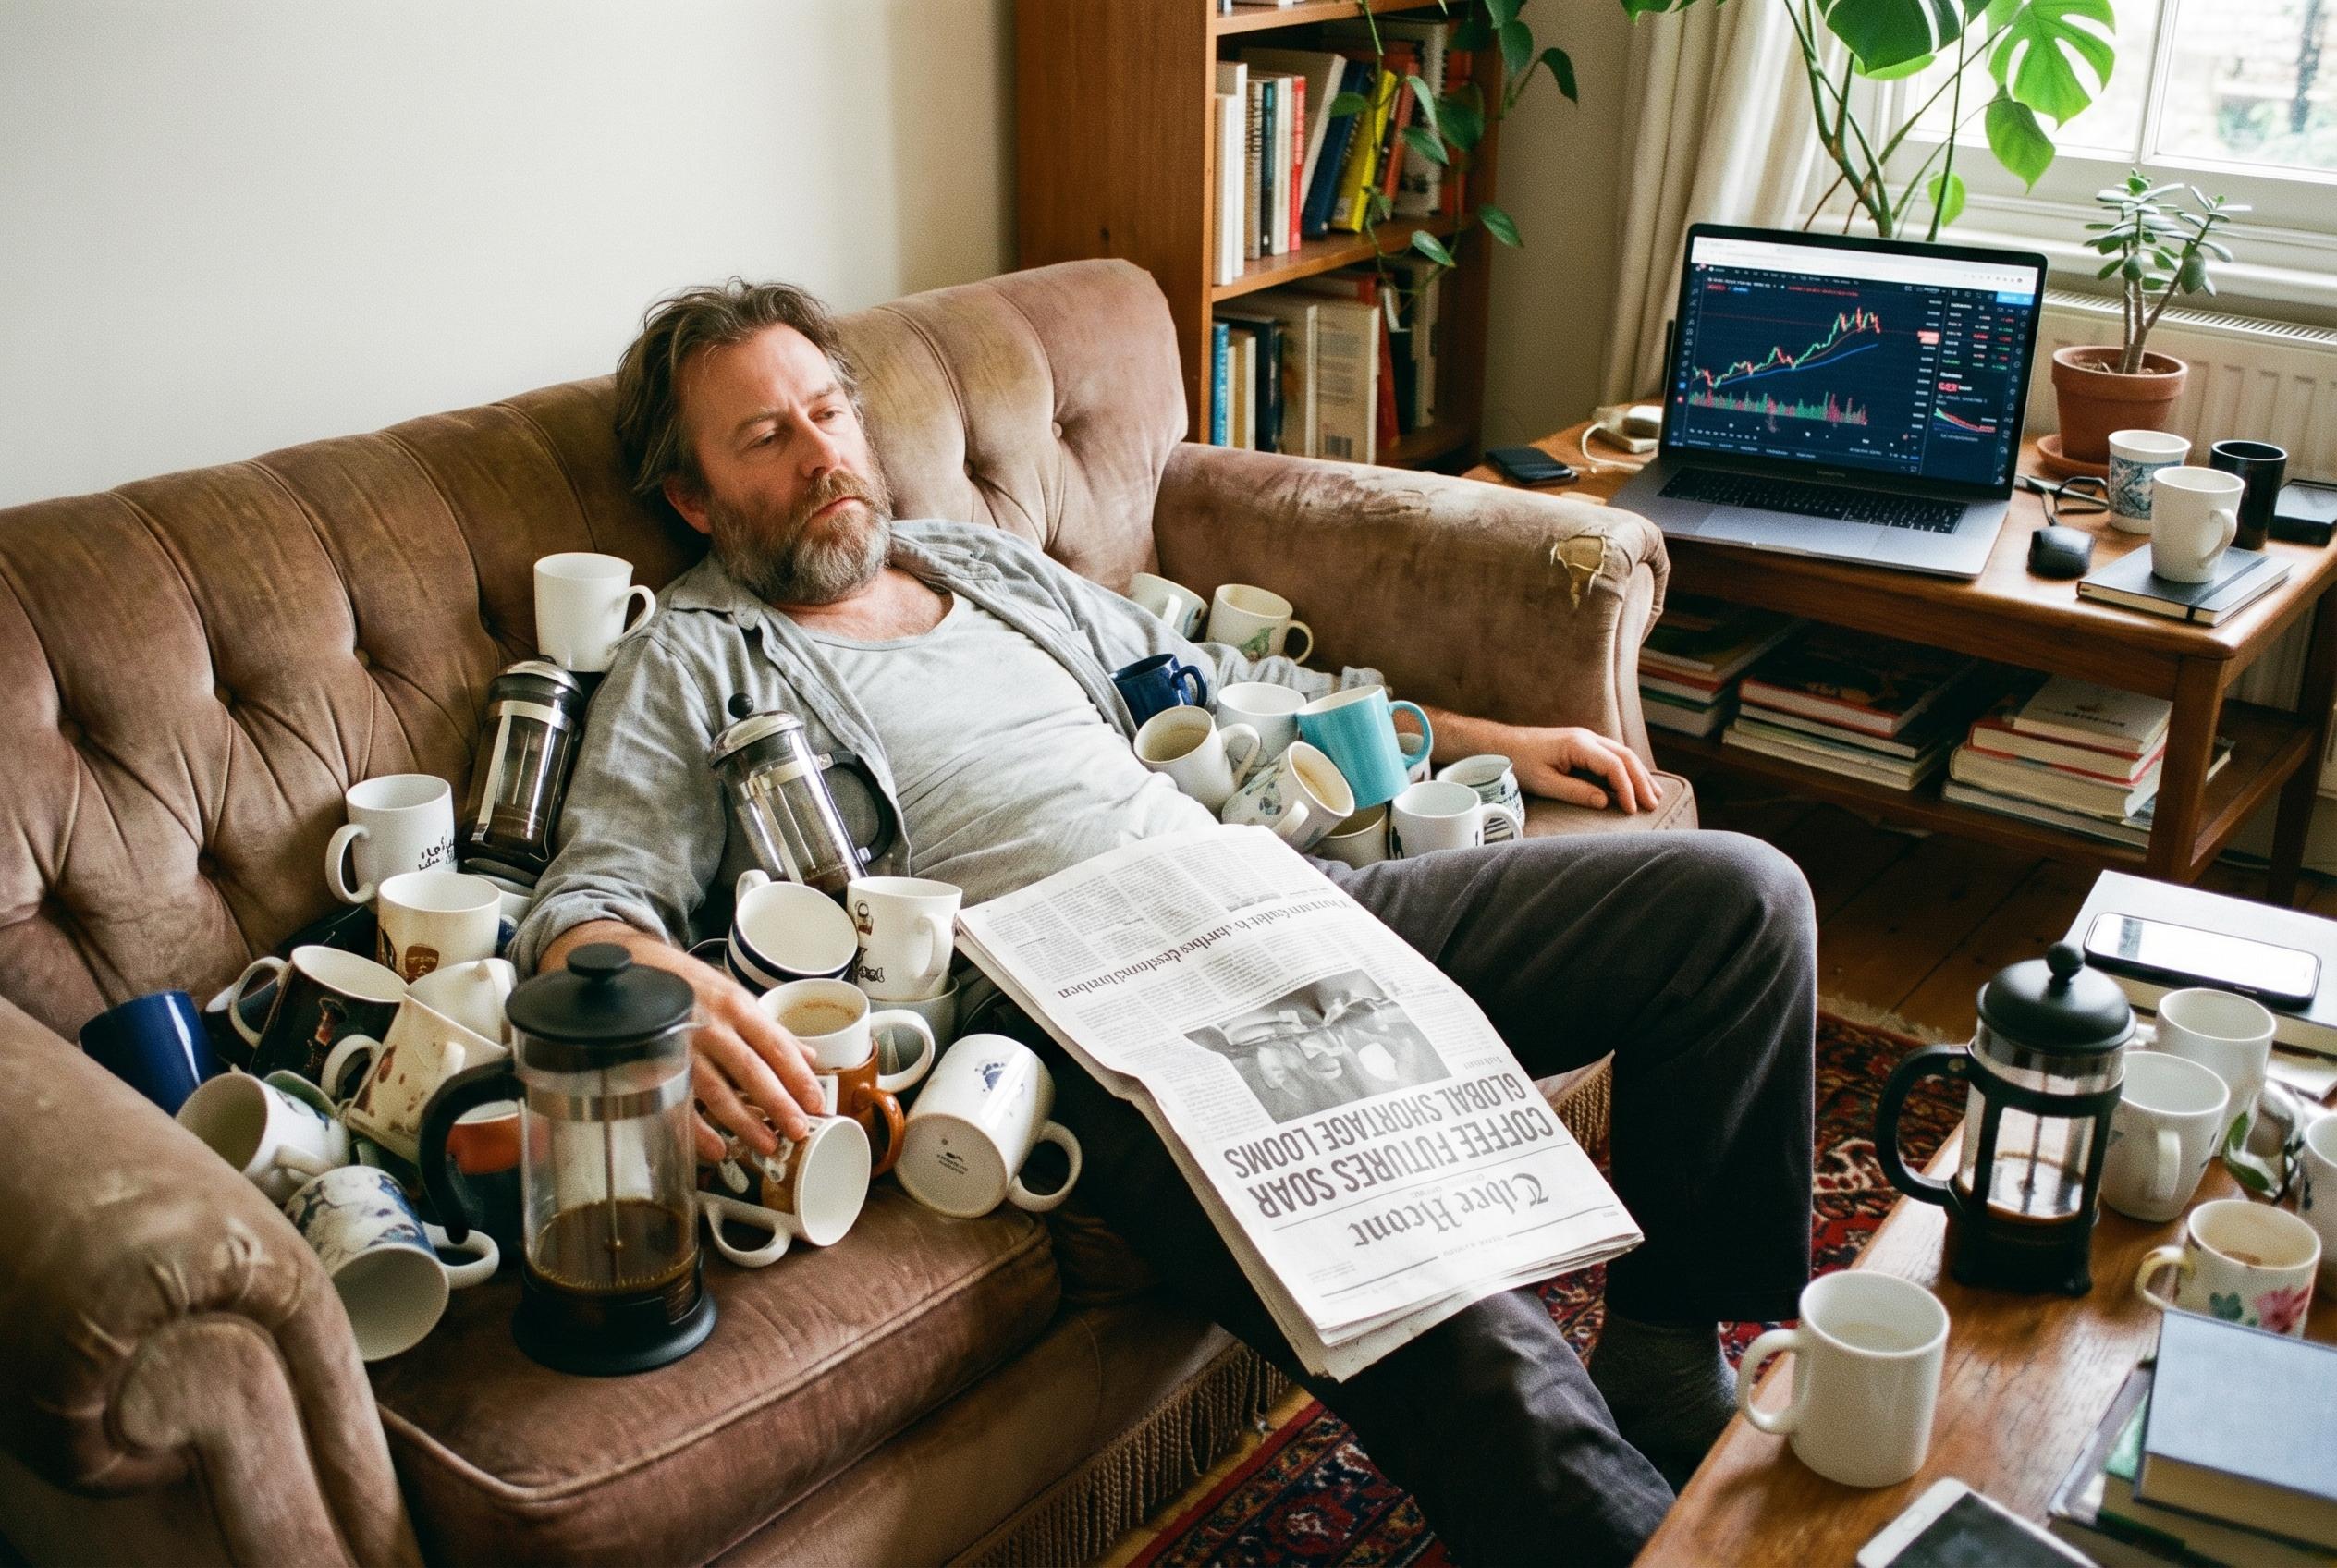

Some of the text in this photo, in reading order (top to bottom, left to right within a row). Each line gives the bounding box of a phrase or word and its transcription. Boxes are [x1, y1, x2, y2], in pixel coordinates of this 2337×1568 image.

[1433, 1072, 1528, 1117] GLOBAL
[1313, 1092, 1443, 1152] SHORTAGE
[1450, 1106, 1555, 1158] COFFEE
[1223, 1126, 1321, 1180] LOOMS
[1330, 1134, 1460, 1193] FUTURES
[1247, 1167, 1337, 1219] SOAR
